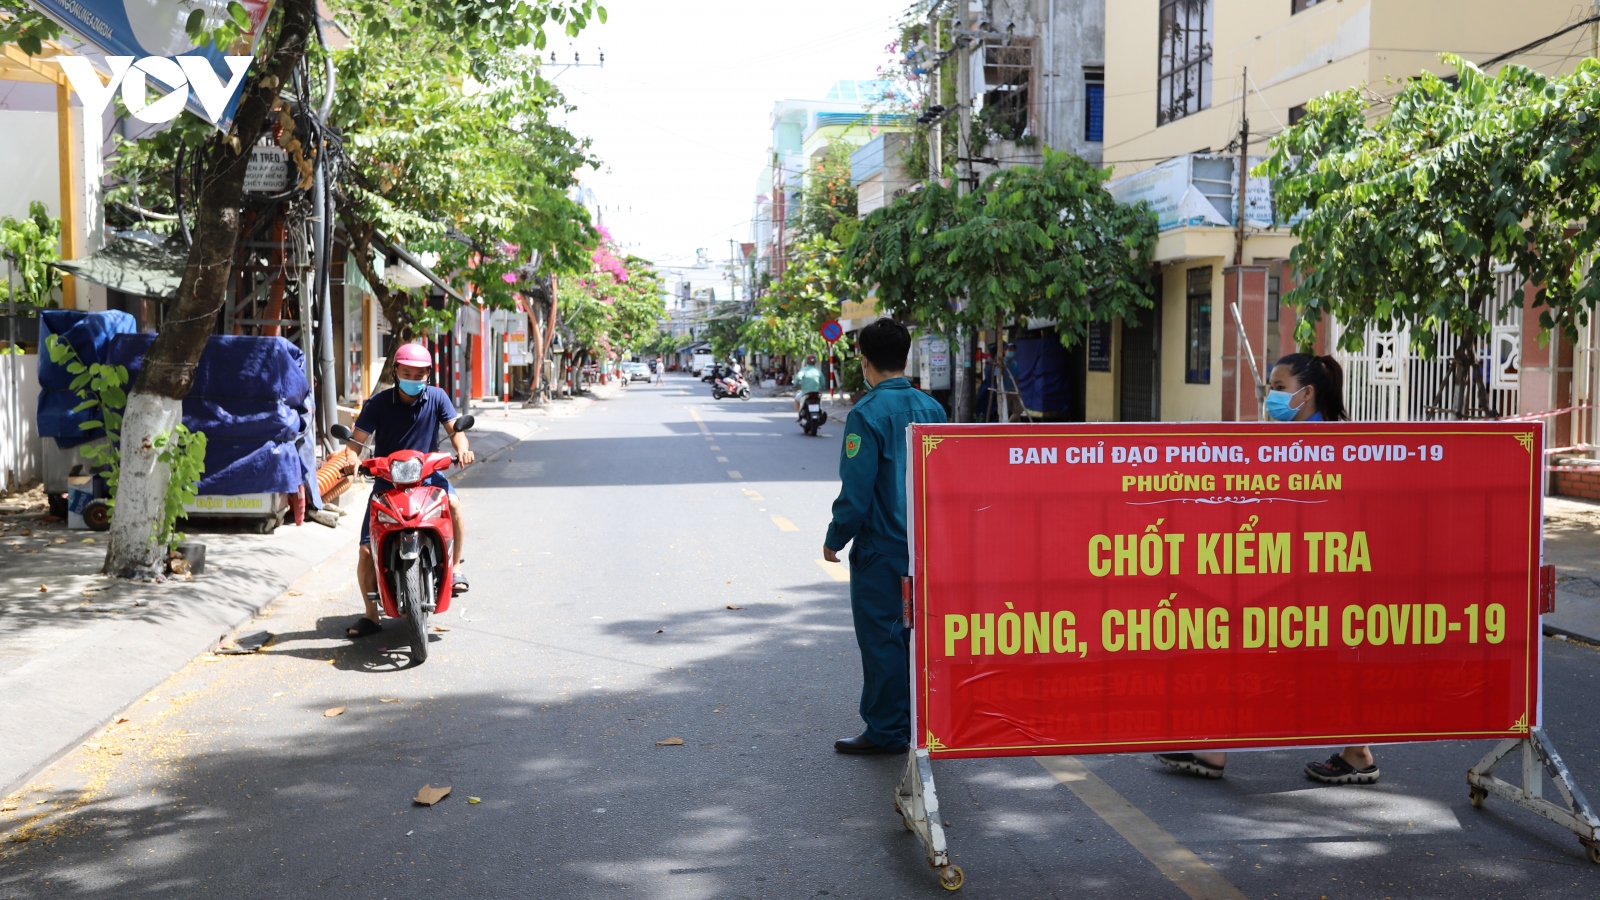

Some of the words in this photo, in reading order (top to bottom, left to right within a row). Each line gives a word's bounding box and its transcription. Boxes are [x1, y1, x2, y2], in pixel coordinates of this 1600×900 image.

[1009, 447, 1058, 465] BAN
[1065, 440, 1105, 464] CHỈ
[1110, 446, 1158, 467] ĐẠO
[1165, 441, 1250, 465] PHÒNG,
[1257, 438, 1335, 463] CHỐNG
[1342, 444, 1443, 463] COVID-19
[1122, 470, 1216, 492] PHƯỜNG
[1222, 474, 1281, 495] THẠC
[1288, 470, 1342, 491] GIÁN
[197, 496, 223, 510] ĐẬU
[226, 497, 263, 509] NÀNH
[1088, 517, 1185, 578] CHỐT
[1197, 514, 1291, 576] KIỂM
[1303, 531, 1372, 574] TRA
[944, 601, 1088, 659] PHÒNG,
[1101, 592, 1230, 653] CHỐNG
[1242, 605, 1329, 654] DỊCH
[1341, 602, 1506, 647] COVID-19
